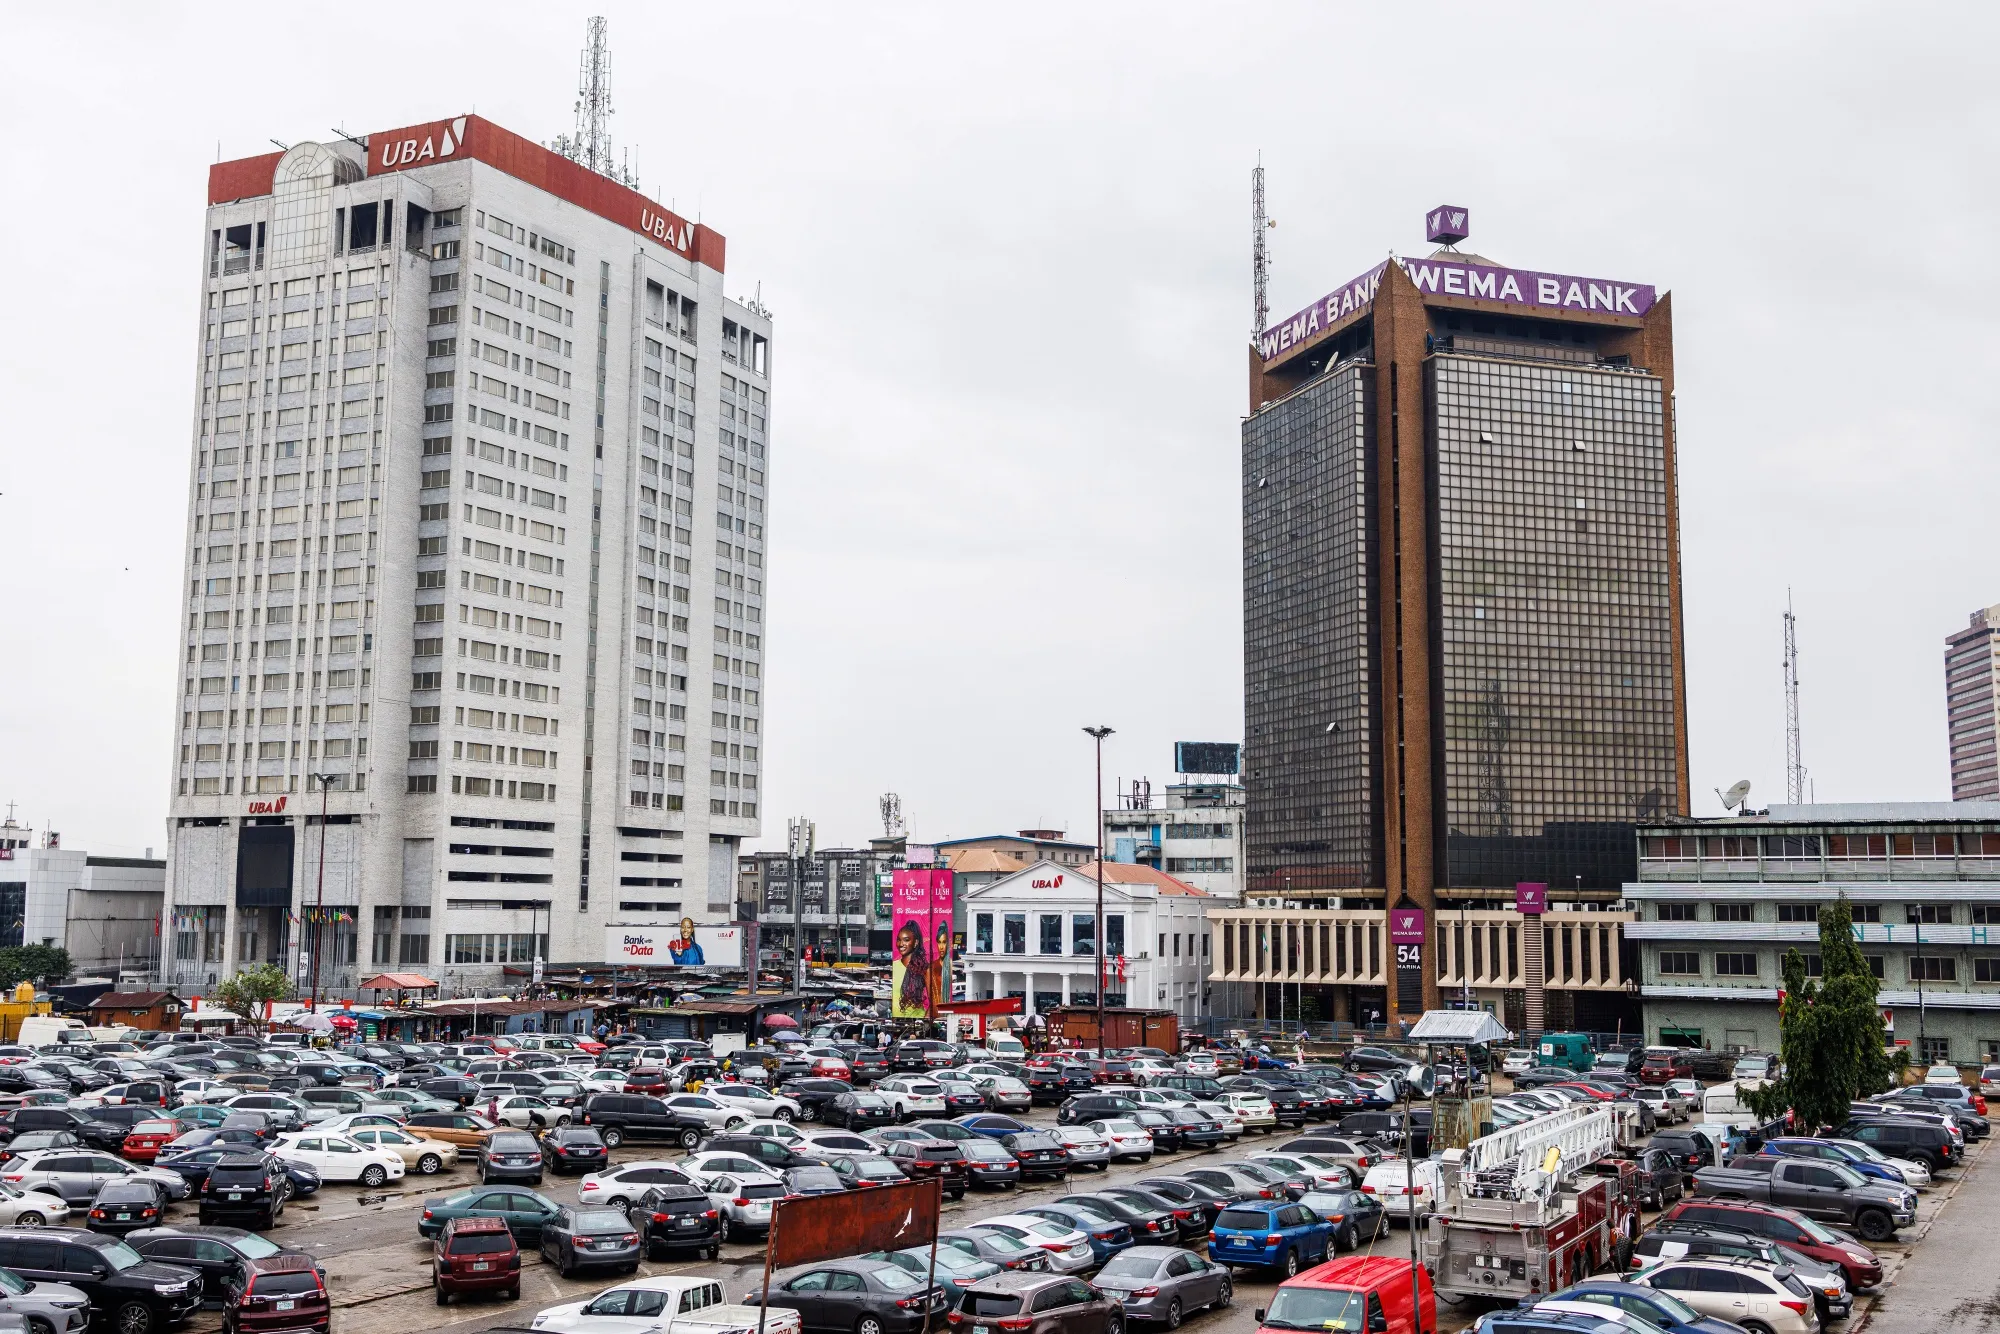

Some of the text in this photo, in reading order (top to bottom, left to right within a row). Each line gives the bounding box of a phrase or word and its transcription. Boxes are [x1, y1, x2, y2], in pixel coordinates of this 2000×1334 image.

[382, 136, 435, 167] UBA
[641, 208, 675, 247] UBA
[1408, 263, 1639, 315] WEMA BANK
[1262, 269, 1384, 361] WEMA BANK
[248, 801, 273, 814] UBA
[1031, 879, 1052, 889] UBA
[899, 888, 925, 896] LUSH
[935, 888, 950, 896] LUSH
[623, 935, 645, 945] Bank
[630, 944, 654, 956] Data
[1397, 945, 1420, 963] 54
